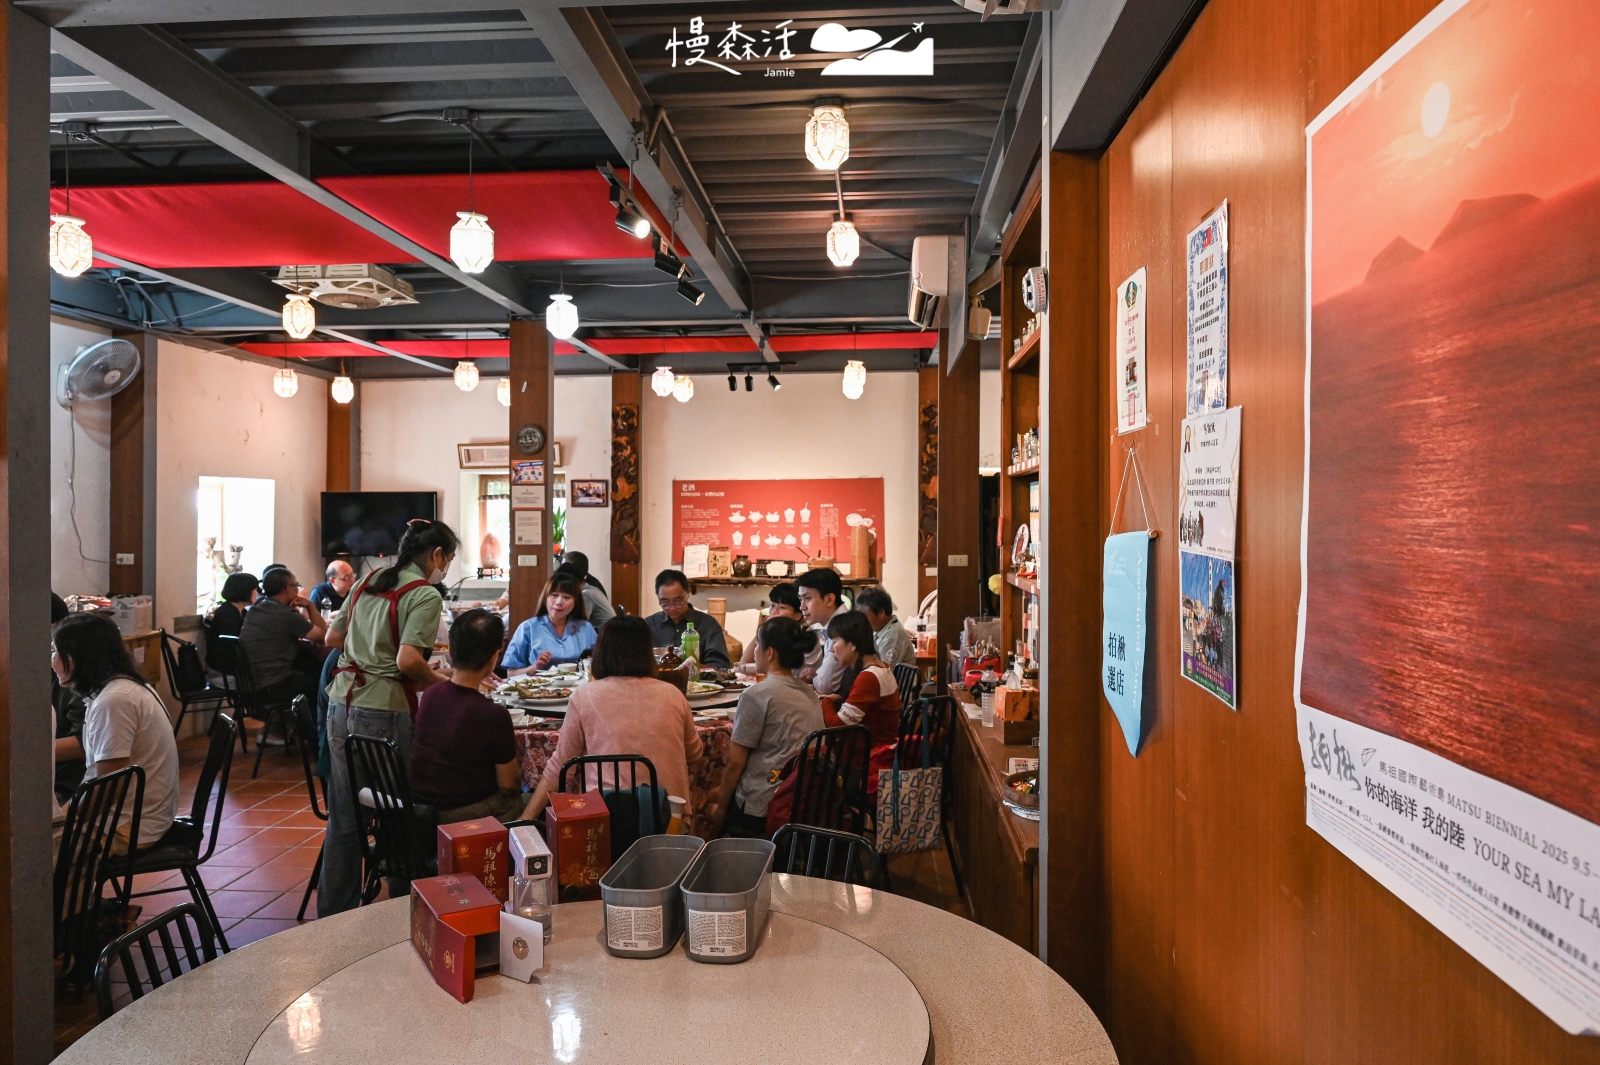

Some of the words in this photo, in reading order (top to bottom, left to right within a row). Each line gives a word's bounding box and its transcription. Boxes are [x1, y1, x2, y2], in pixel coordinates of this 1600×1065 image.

[1107, 665, 1124, 696] 選店
[1365, 776, 1418, 821] 你的海洋
[1422, 806, 1466, 851] 我的陸
[1473, 837, 1510, 874] YOUR
[1514, 861, 1542, 893] SEA
[1547, 879, 1575, 910] MY
[1379, 761, 1445, 802] 馬祖國際藝術島
[1447, 793, 1482, 819] MATSU
[1485, 811, 1538, 849] BIENNIAL
[1541, 840, 1569, 864] 2025
